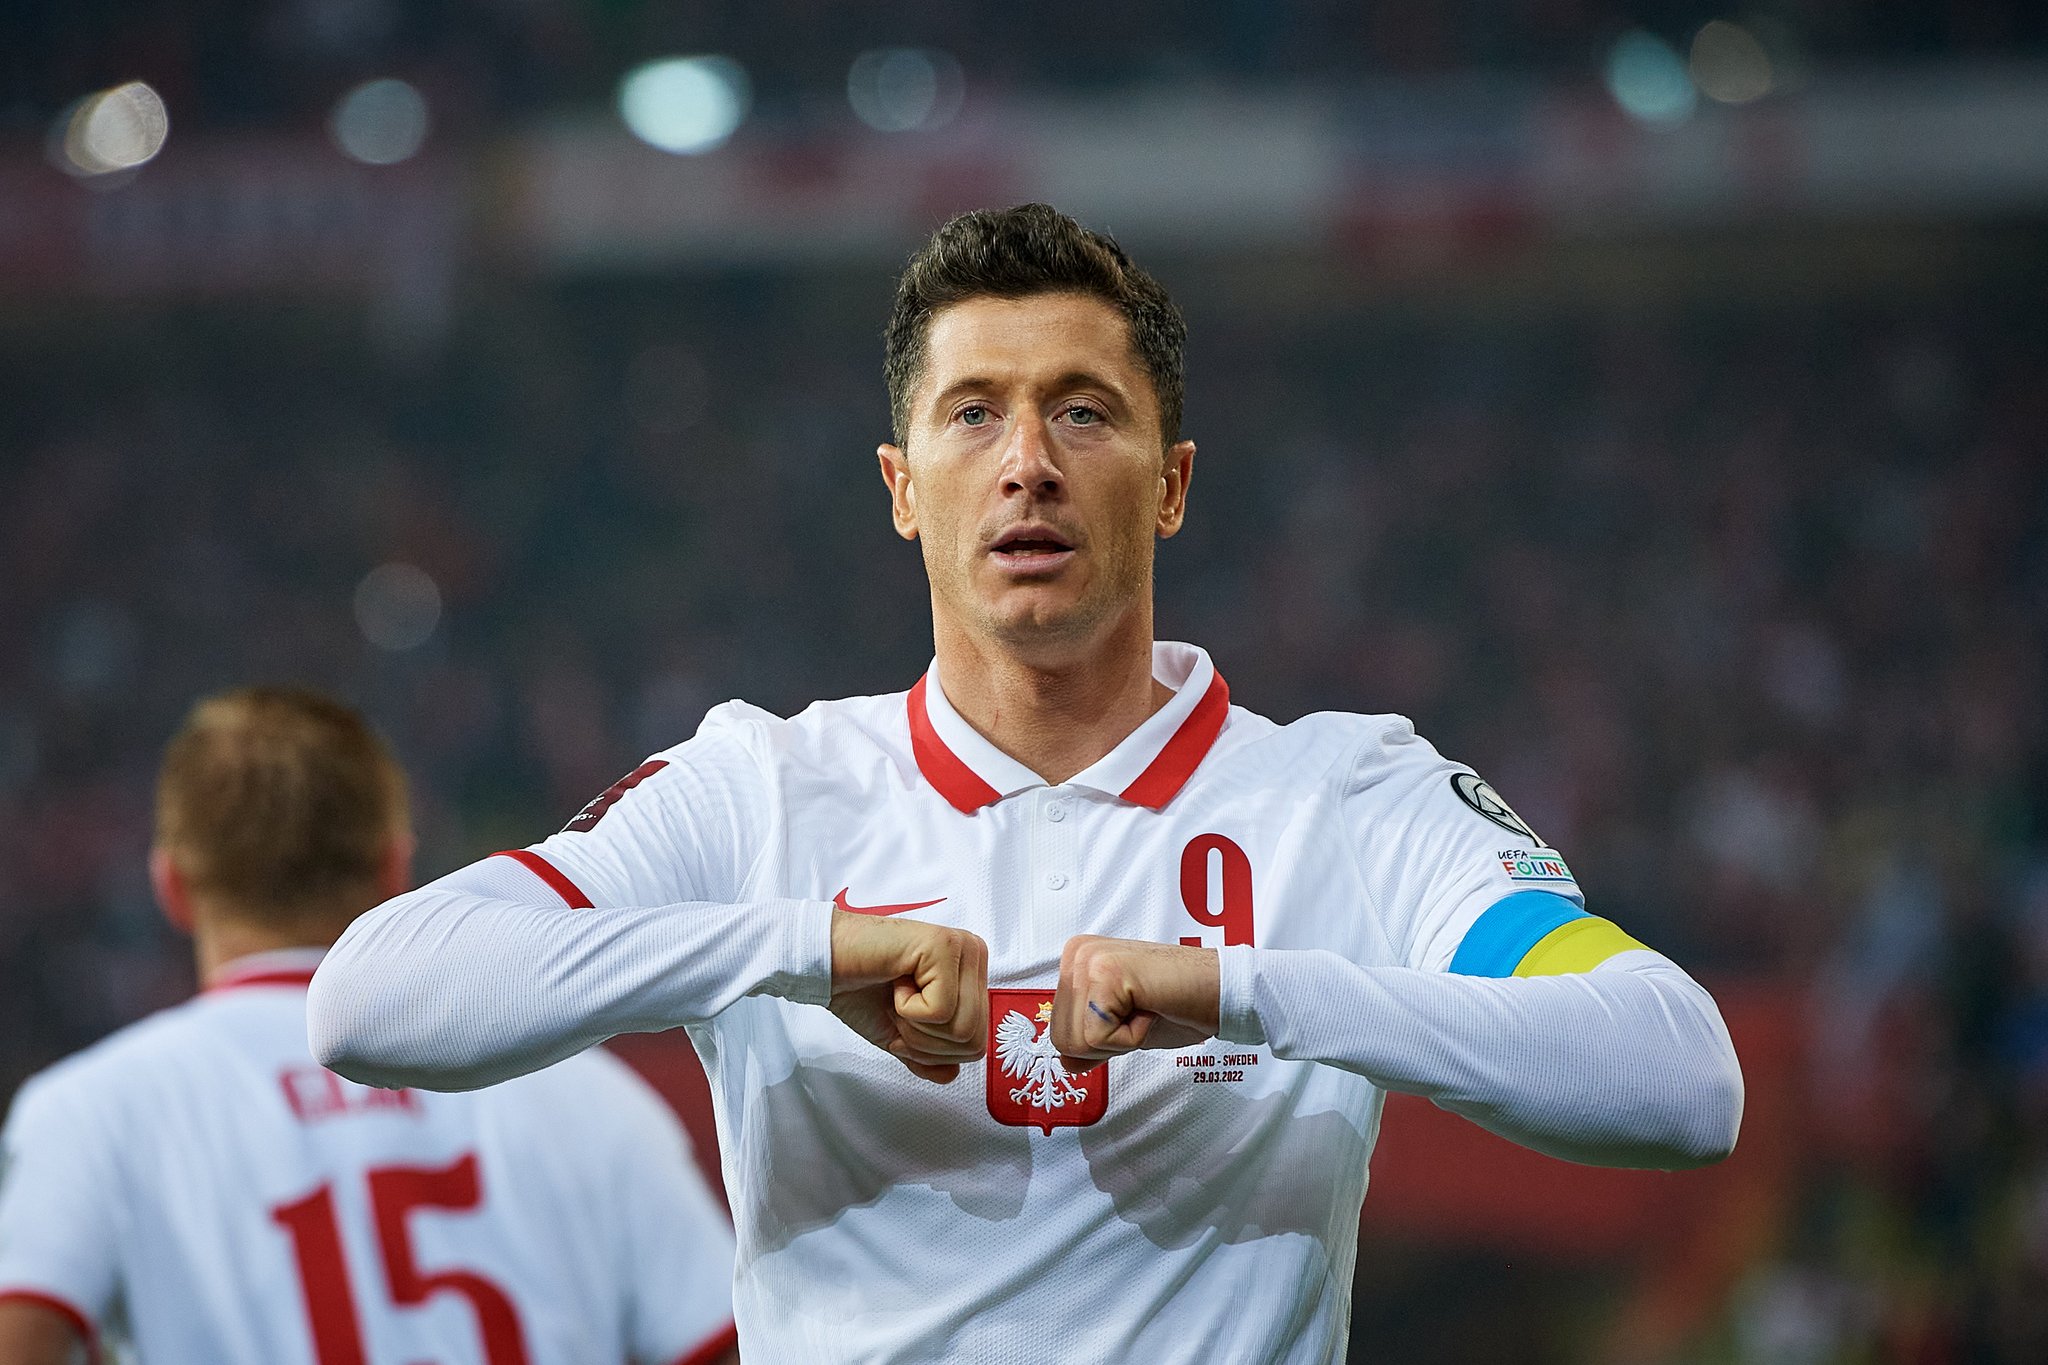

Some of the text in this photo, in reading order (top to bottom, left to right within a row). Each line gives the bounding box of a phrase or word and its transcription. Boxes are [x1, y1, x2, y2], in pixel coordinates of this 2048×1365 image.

[1498, 850, 1528, 860] UEFA
[1180, 833, 1255, 949] 9
[1176, 1055, 1215, 1067] POLAND
[1223, 1054, 1258, 1066] SWEDEN
[1194, 1070, 1244, 1083] 29.03.2022
[269, 1149, 532, 1365] 15
